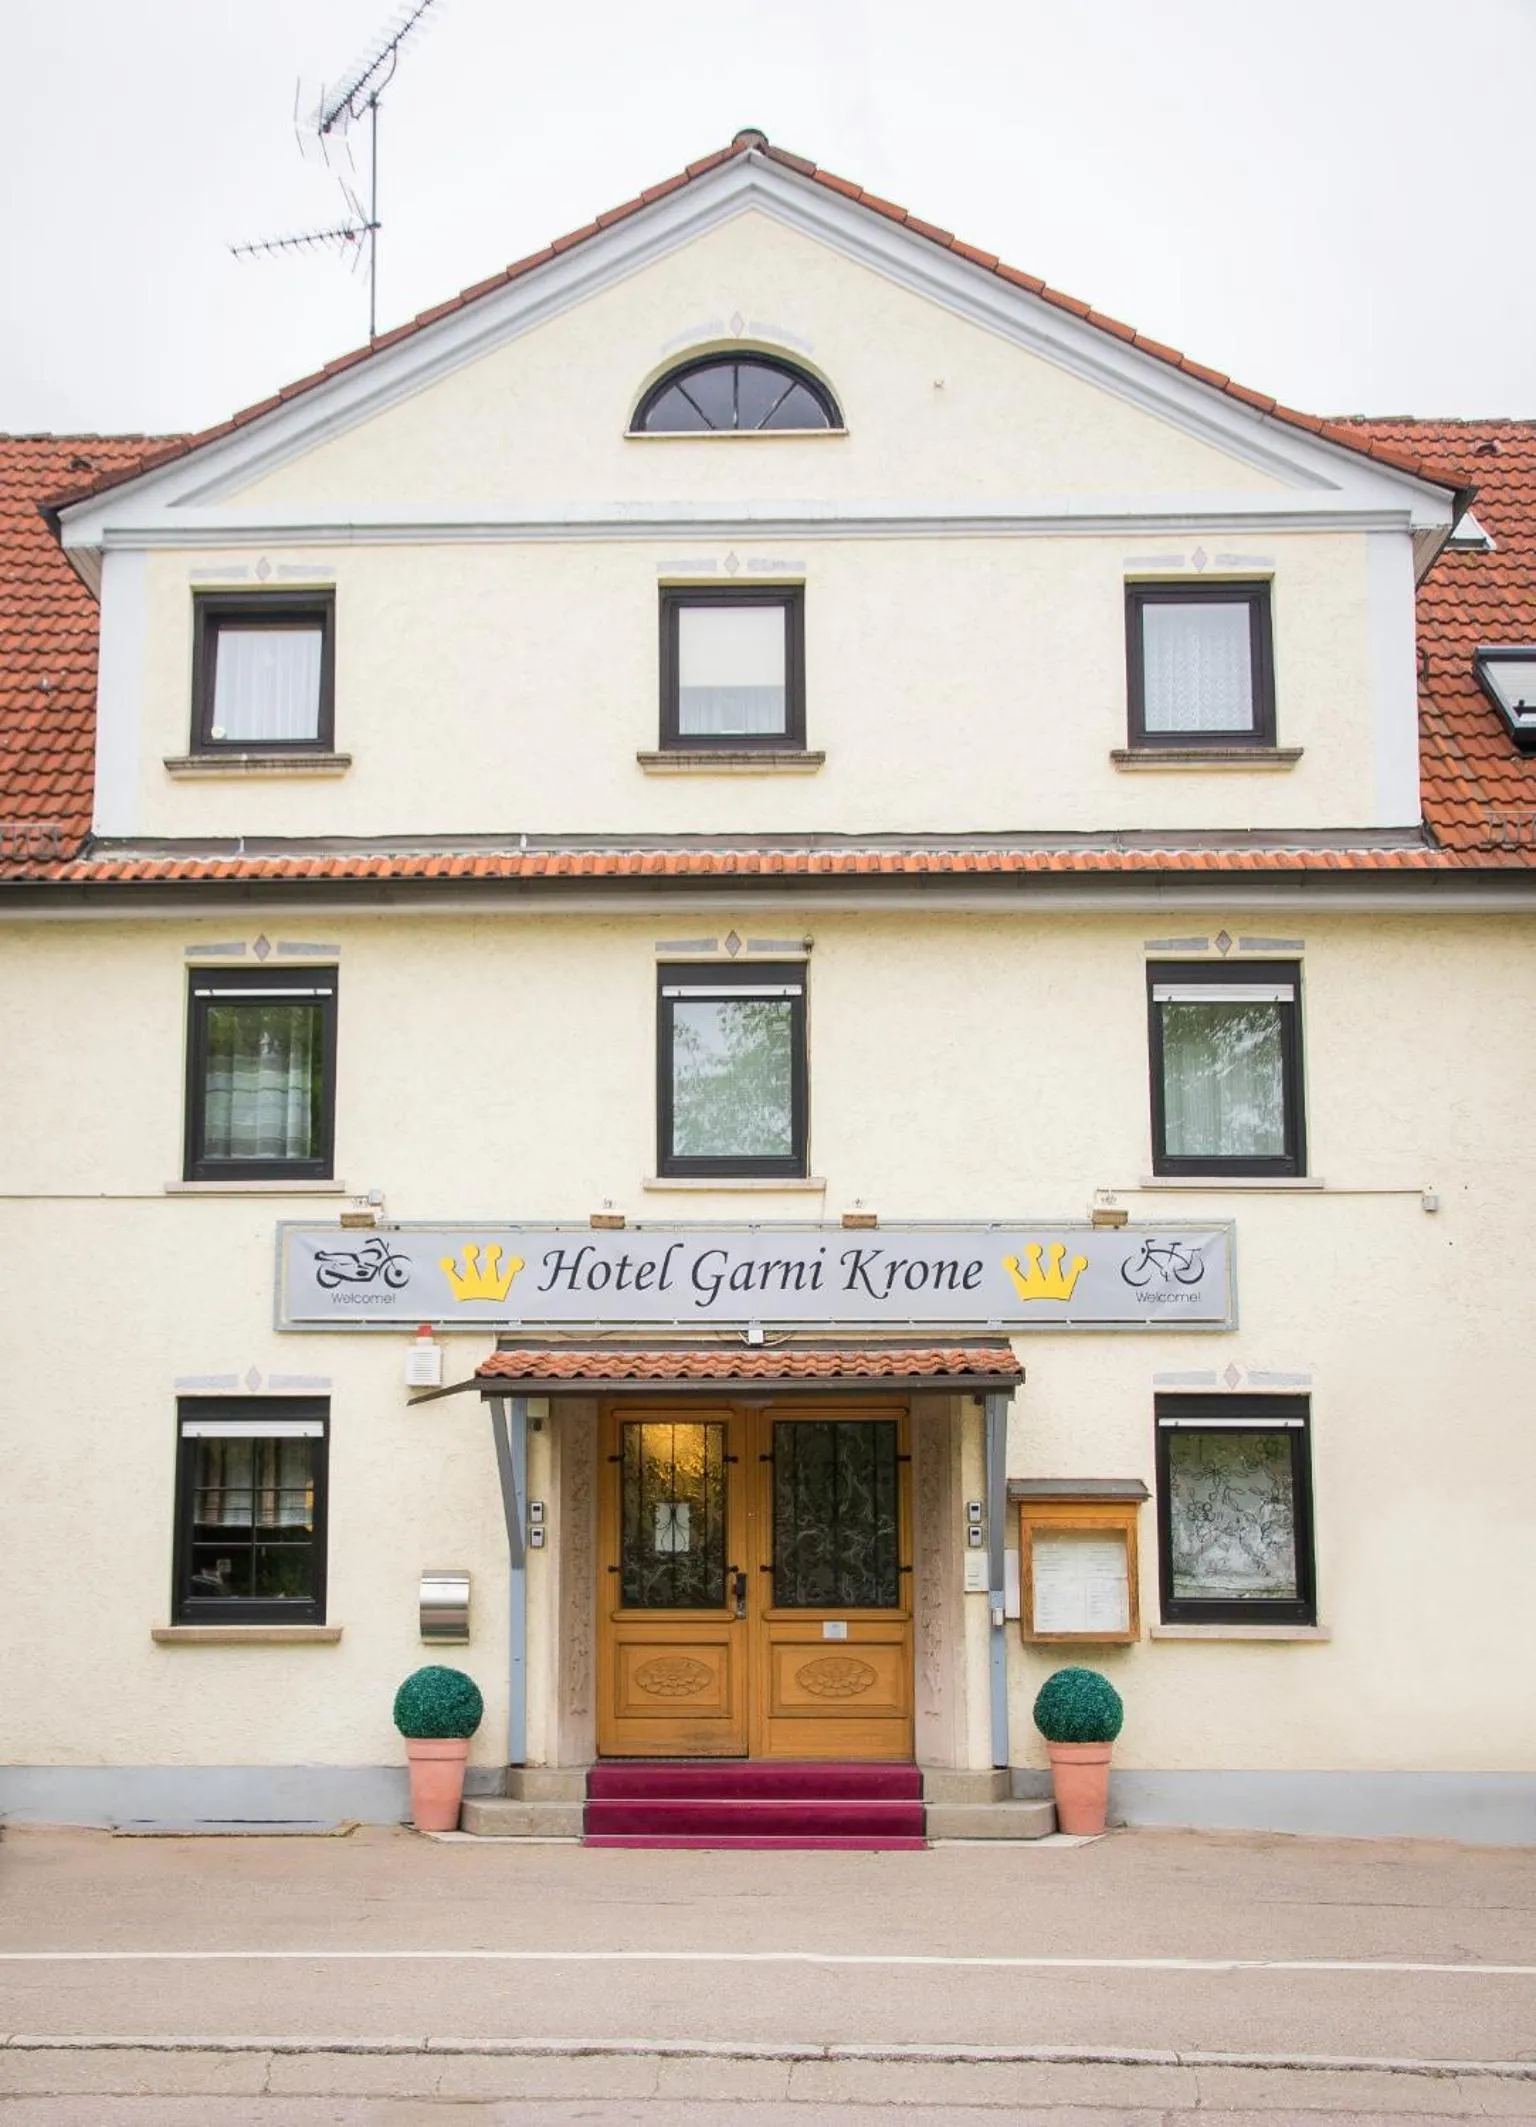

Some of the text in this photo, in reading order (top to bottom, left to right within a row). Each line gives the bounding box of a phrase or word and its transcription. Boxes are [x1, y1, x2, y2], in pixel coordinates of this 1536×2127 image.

[537, 1243, 984, 1308] Hotel Garni Krone
[331, 1292, 396, 1305] Welcome!
[1135, 1292, 1201, 1304] Welcome!
